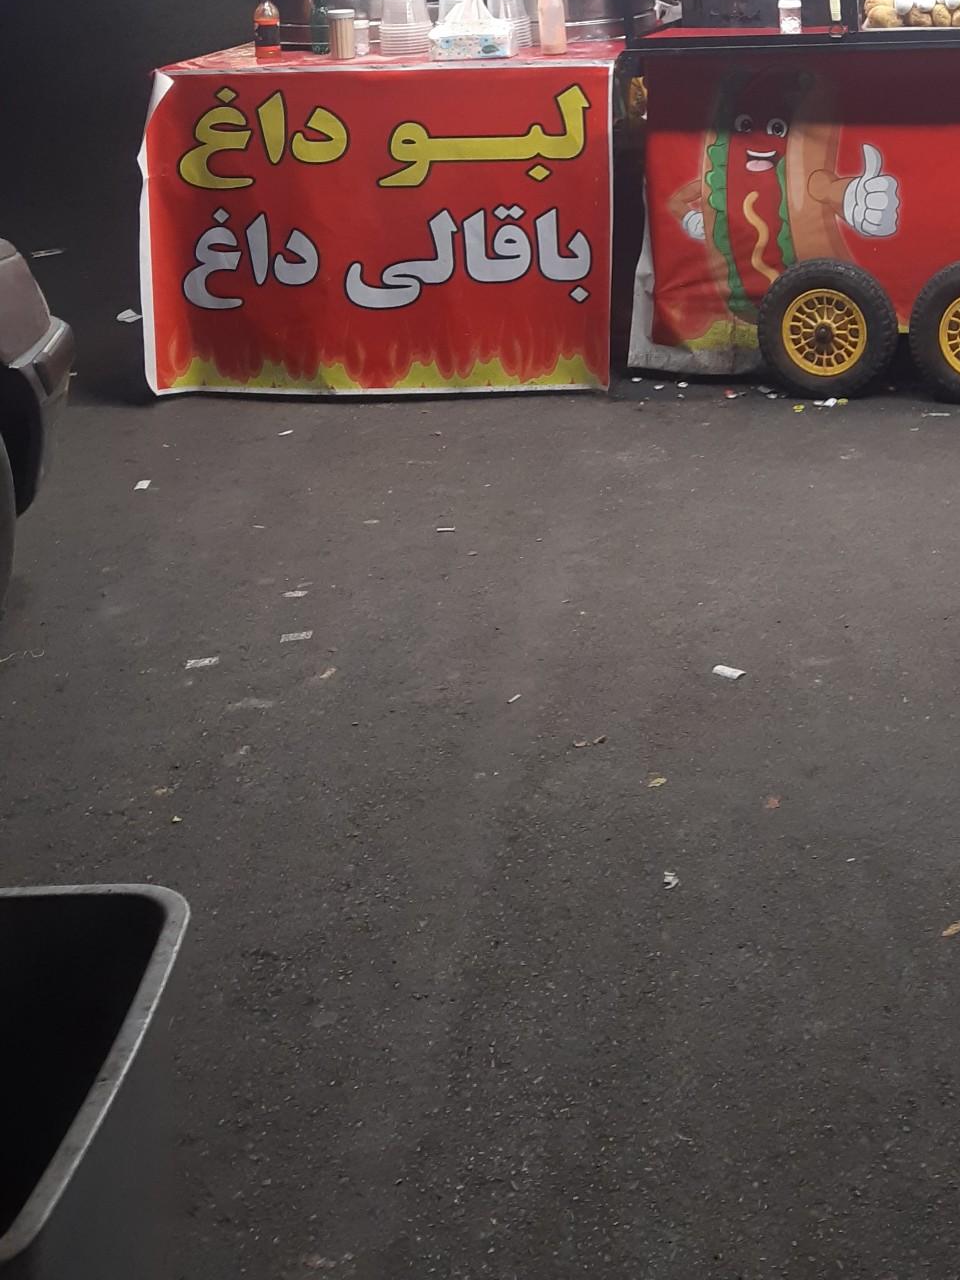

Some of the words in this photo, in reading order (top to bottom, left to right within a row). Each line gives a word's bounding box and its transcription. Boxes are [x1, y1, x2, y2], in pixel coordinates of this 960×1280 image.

[177, 85, 351, 190] داغ
[376, 81, 592, 188] لبو
[181, 206, 321, 310] داغ
[344, 202, 594, 310] باقالی
